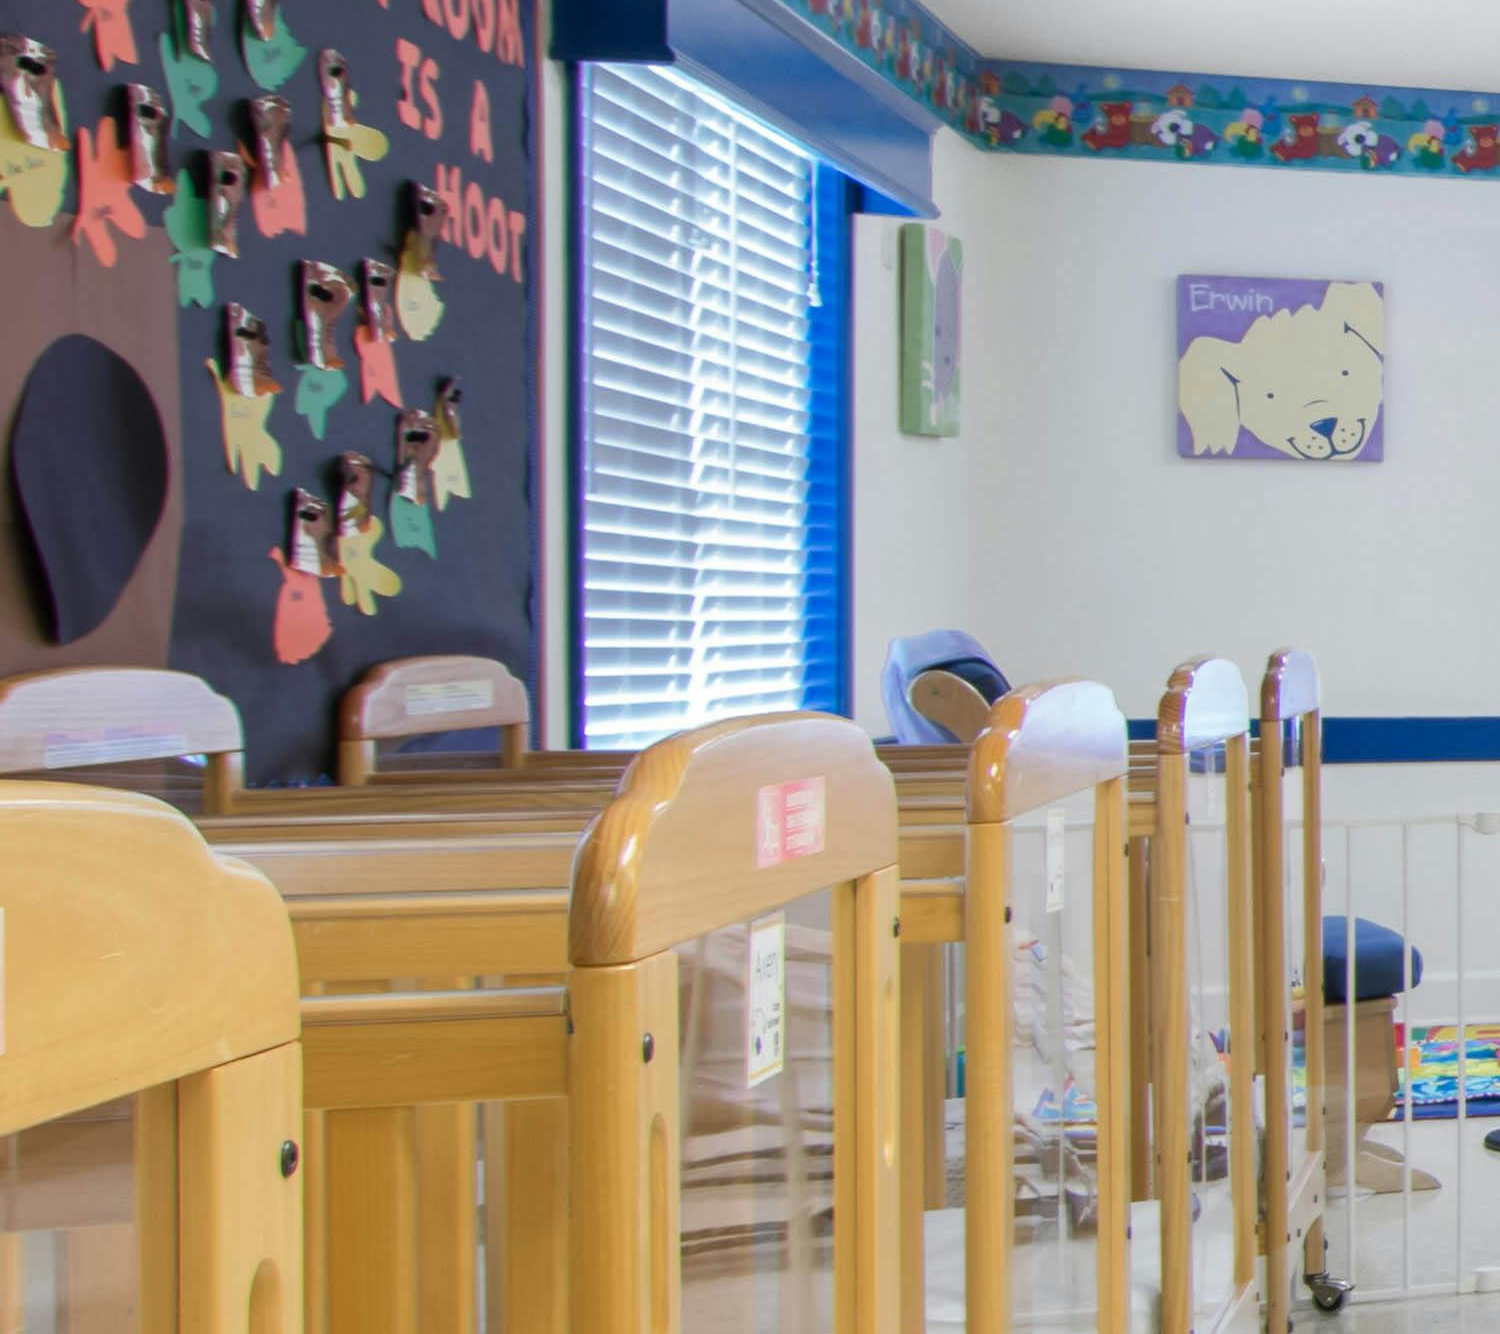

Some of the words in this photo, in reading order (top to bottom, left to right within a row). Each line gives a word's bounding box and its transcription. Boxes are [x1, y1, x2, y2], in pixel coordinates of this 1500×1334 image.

[396, 38, 442, 140] IS
[469, 79, 493, 164] A
[435, 163, 526, 283] HOOT
[1189, 283, 1274, 312] Erwin
